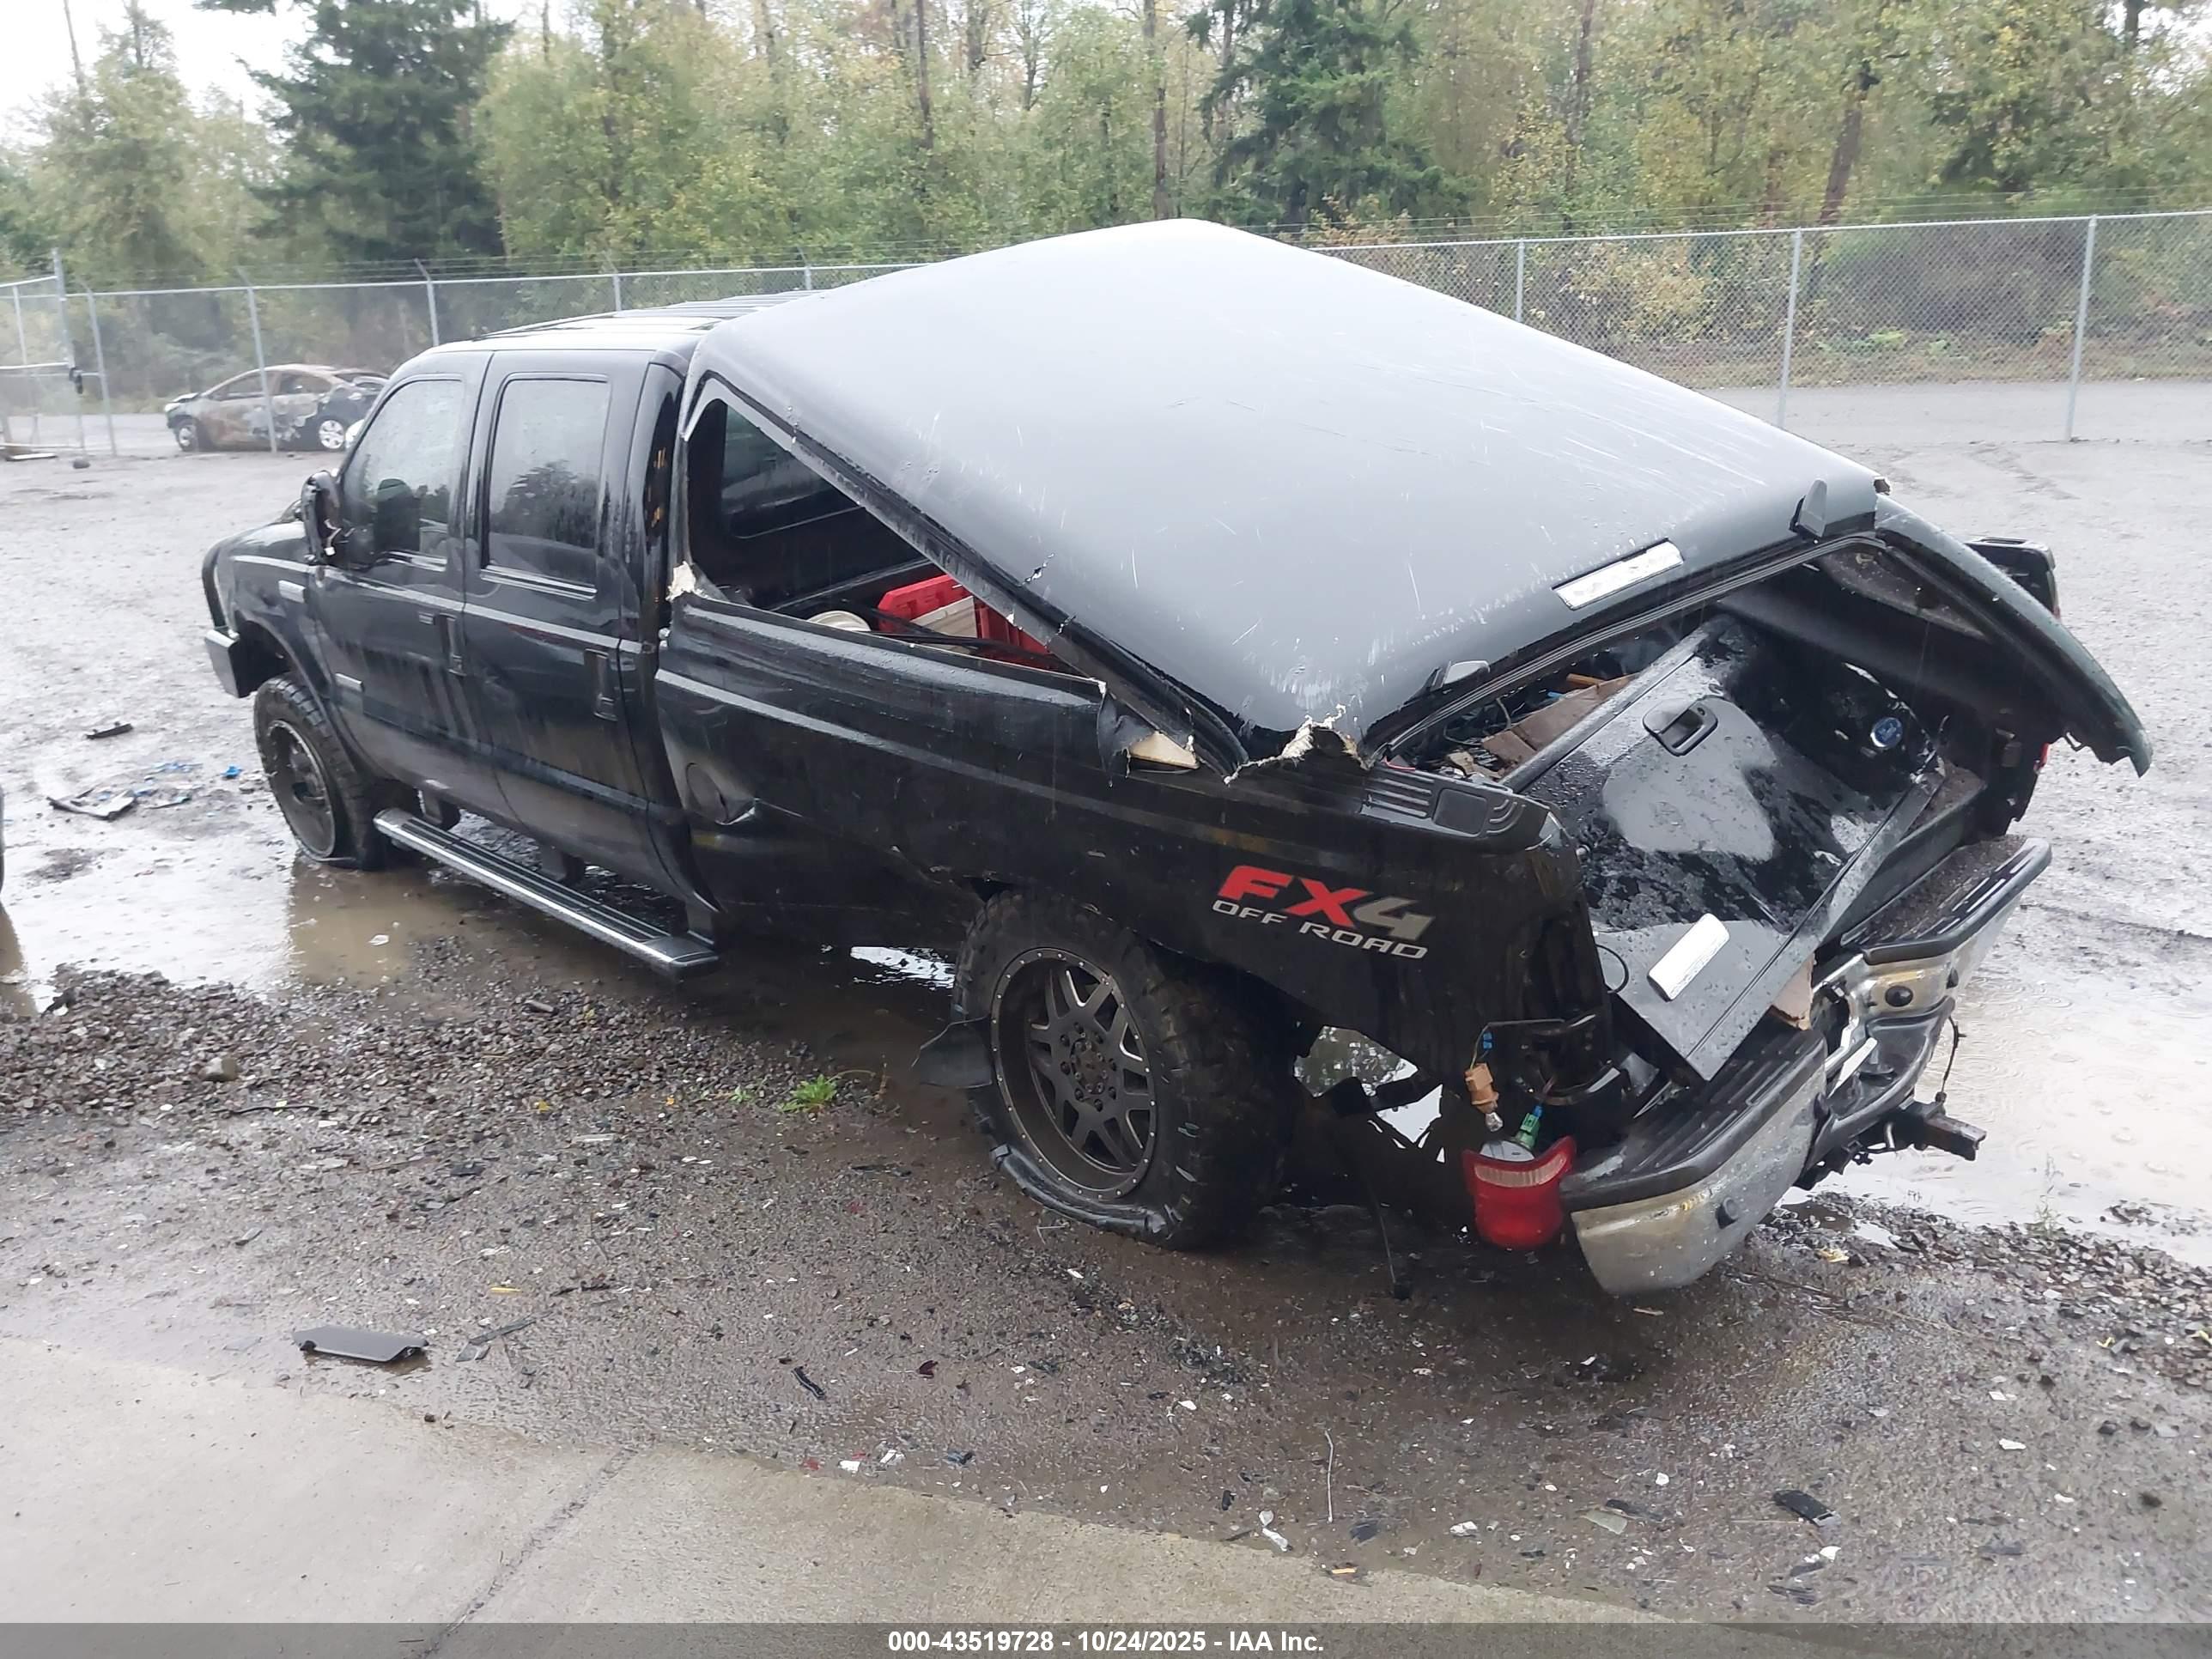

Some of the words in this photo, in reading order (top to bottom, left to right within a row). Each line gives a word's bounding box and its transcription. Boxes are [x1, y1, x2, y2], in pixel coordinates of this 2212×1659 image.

[1212, 900, 1287, 924] OFF
[1299, 921, 1428, 959] ROAD
[1218, 865, 1436, 940] FX4
